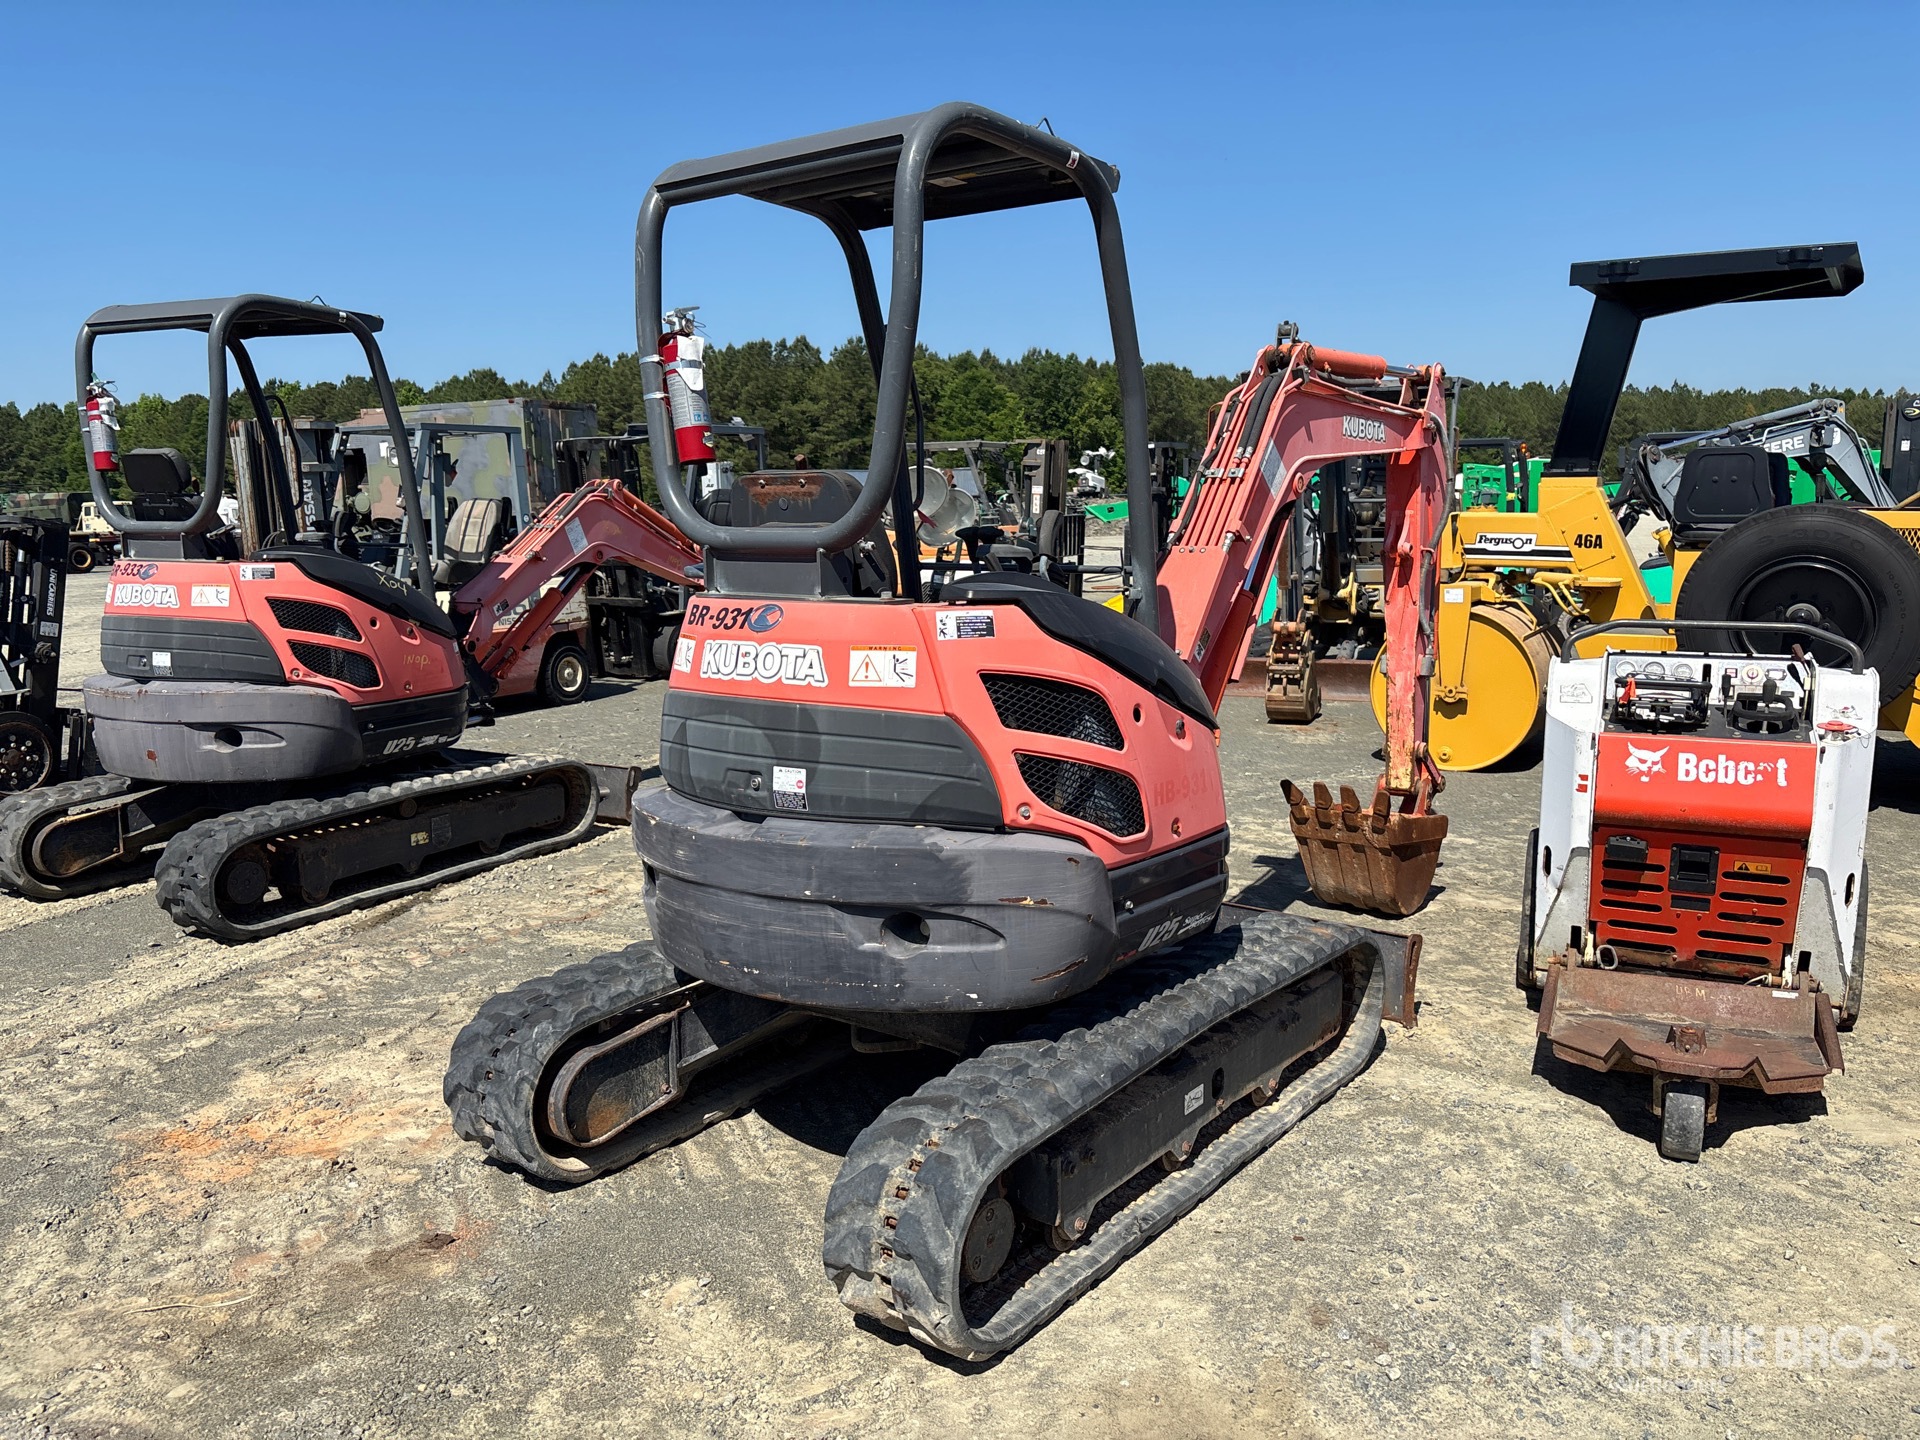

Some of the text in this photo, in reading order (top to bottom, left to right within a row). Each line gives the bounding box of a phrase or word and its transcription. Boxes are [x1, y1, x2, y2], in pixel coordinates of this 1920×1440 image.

[1342, 414, 1386, 443] KUBOTA
[1763, 435, 1805, 453] EERE
[303, 479, 318, 533] ISSAN
[1477, 534, 1533, 550] Ferguson
[1573, 533, 1603, 549] 46A
[46, 568, 58, 618] UNICARRIERS
[114, 584, 180, 608] KUBOTA
[687, 603, 754, 630] BR-931
[702, 641, 827, 686] KUBOTA
[383, 736, 415, 755] U25
[1138, 915, 1183, 952] U25
